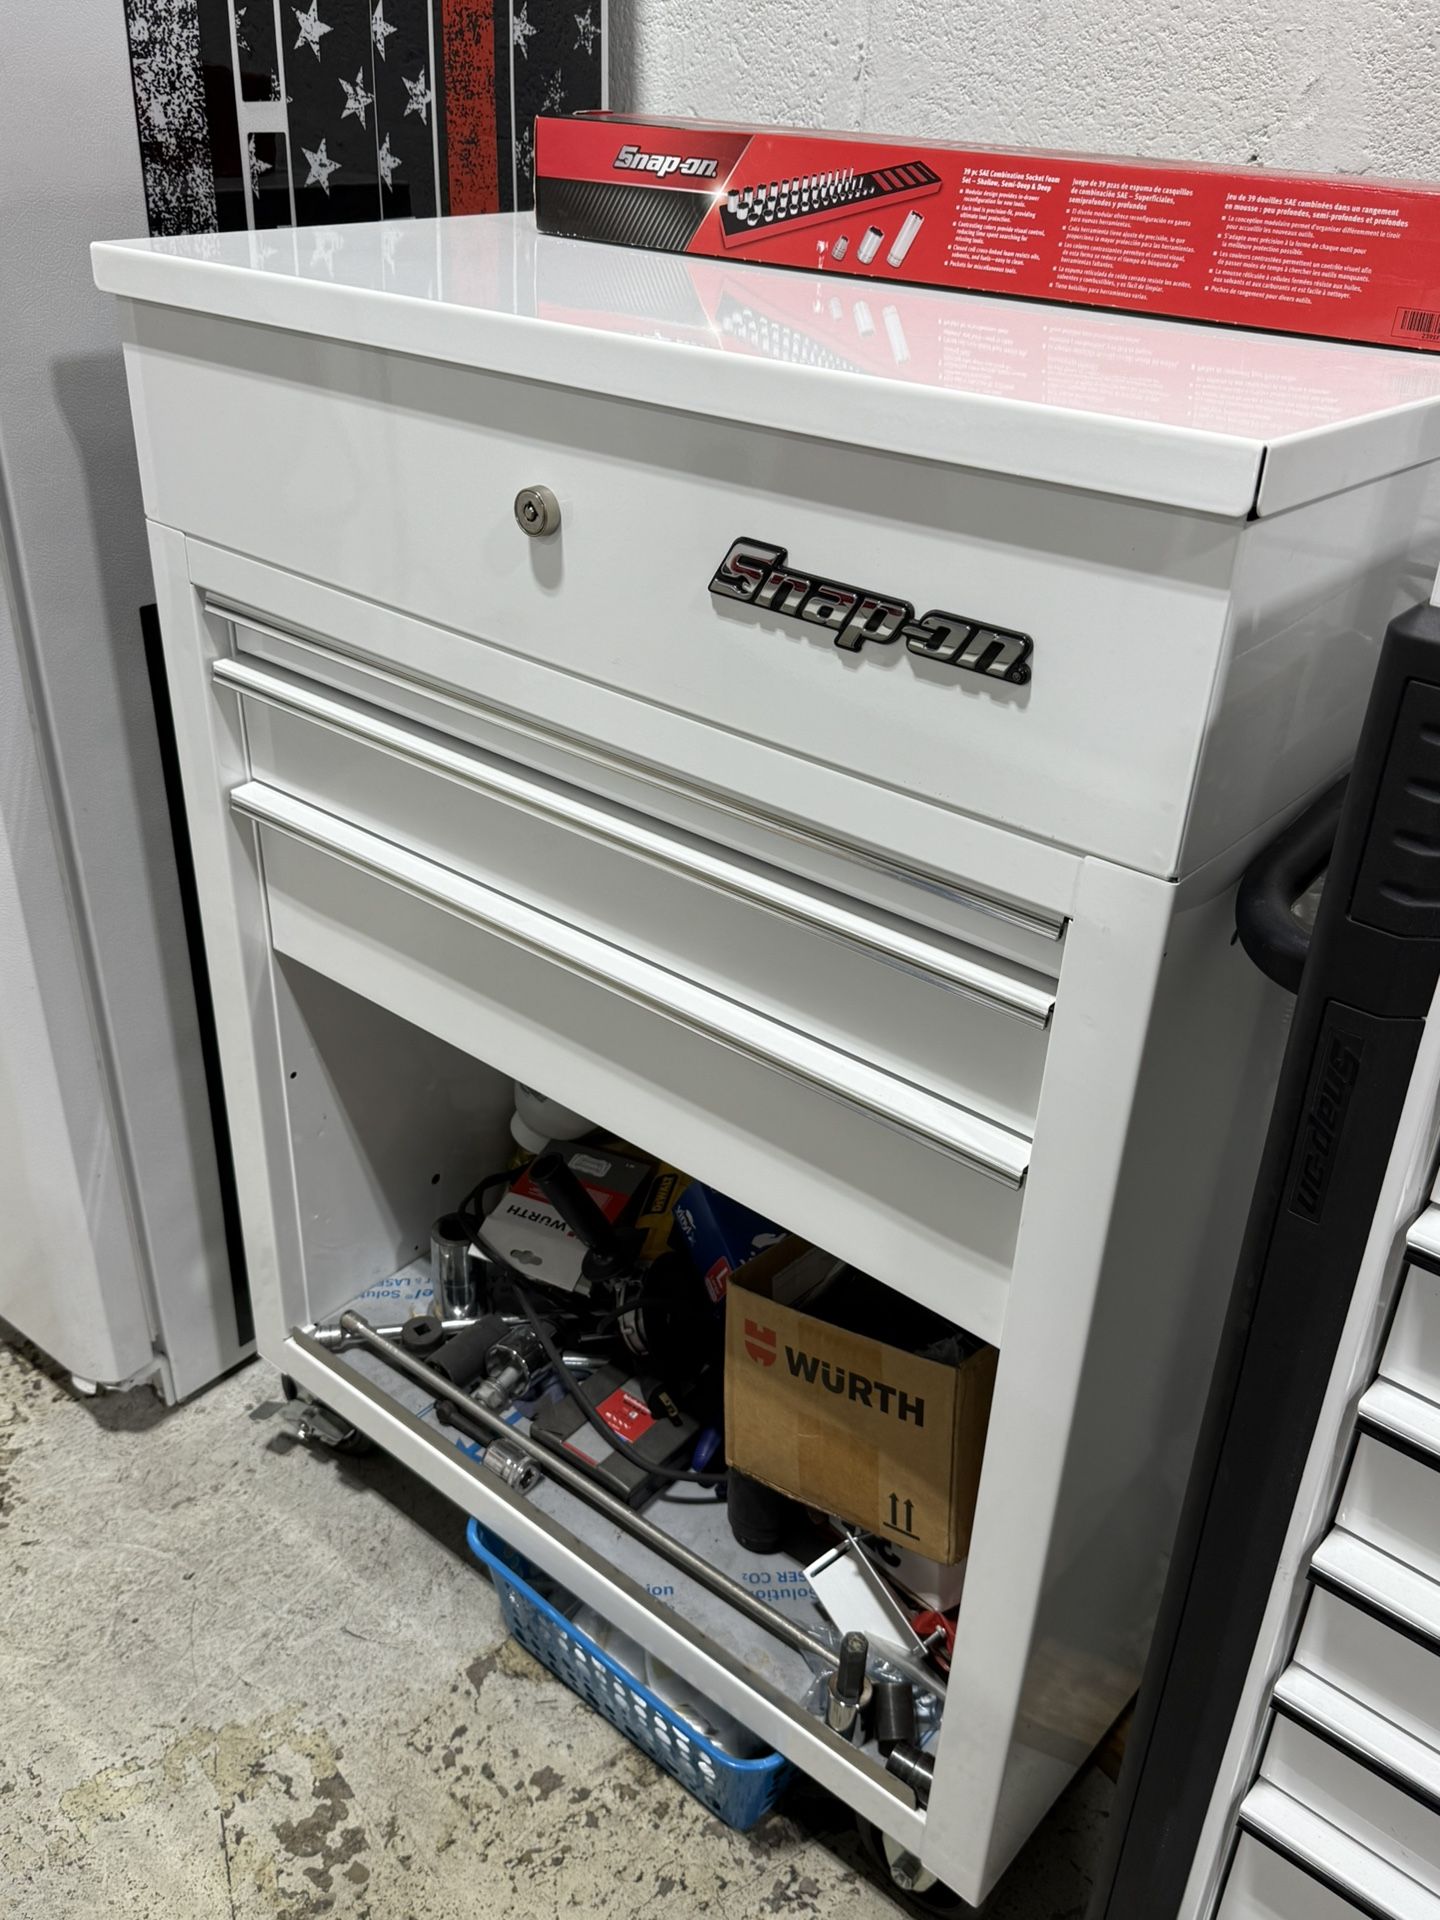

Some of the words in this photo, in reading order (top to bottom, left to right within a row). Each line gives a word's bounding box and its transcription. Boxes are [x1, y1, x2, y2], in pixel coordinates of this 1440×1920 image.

[613, 144, 718, 178] Snap-on
[961, 176, 972, 184] Set
[976, 177, 1000, 187] Shallow,
[1000, 179, 1031, 191] Semi-Deep
[1036, 183, 1052, 193] Deep
[978, 168, 990, 177] SAE
[989, 170, 1025, 180] Combination
[1024, 173, 1045, 182] Socket
[1044, 174, 1060, 183] Foam
[1071, 178, 1089, 187] Juego
[1089, 179, 1098, 187] de
[1129, 184, 1153, 192] espuma
[1162, 187, 1193, 196] casquillos
[1078, 188, 1116, 198] combinación
[1116, 191, 1128, 199] SAE
[1134, 192, 1175, 204] Superficiales,
[1068, 196, 1111, 207] semiprofundos
[1116, 201, 1147, 210] profundos
[1226, 192, 1237, 201] Jeu
[1237, 194, 1246, 202] de
[1256, 195, 1283, 205] douilles
[1283, 198, 1297, 206] SAE
[1297, 200, 1333, 210] combinées
[1333, 202, 1350, 211] dans
[1361, 207, 1399, 216] rangement
[1275, 208, 1311, 218] profondes,
[1312, 211, 1364, 223] semi-profondes
[1373, 217, 1408, 228] profondes
[709, 537, 1032, 683] Snap-on
[1297, 1038, 1360, 1214] Snap-on
[507, 1204, 566, 1232] WÜRTH
[784, 1345, 925, 1428] WÜRTH
[751, 1586, 818, 1601] Solutio
